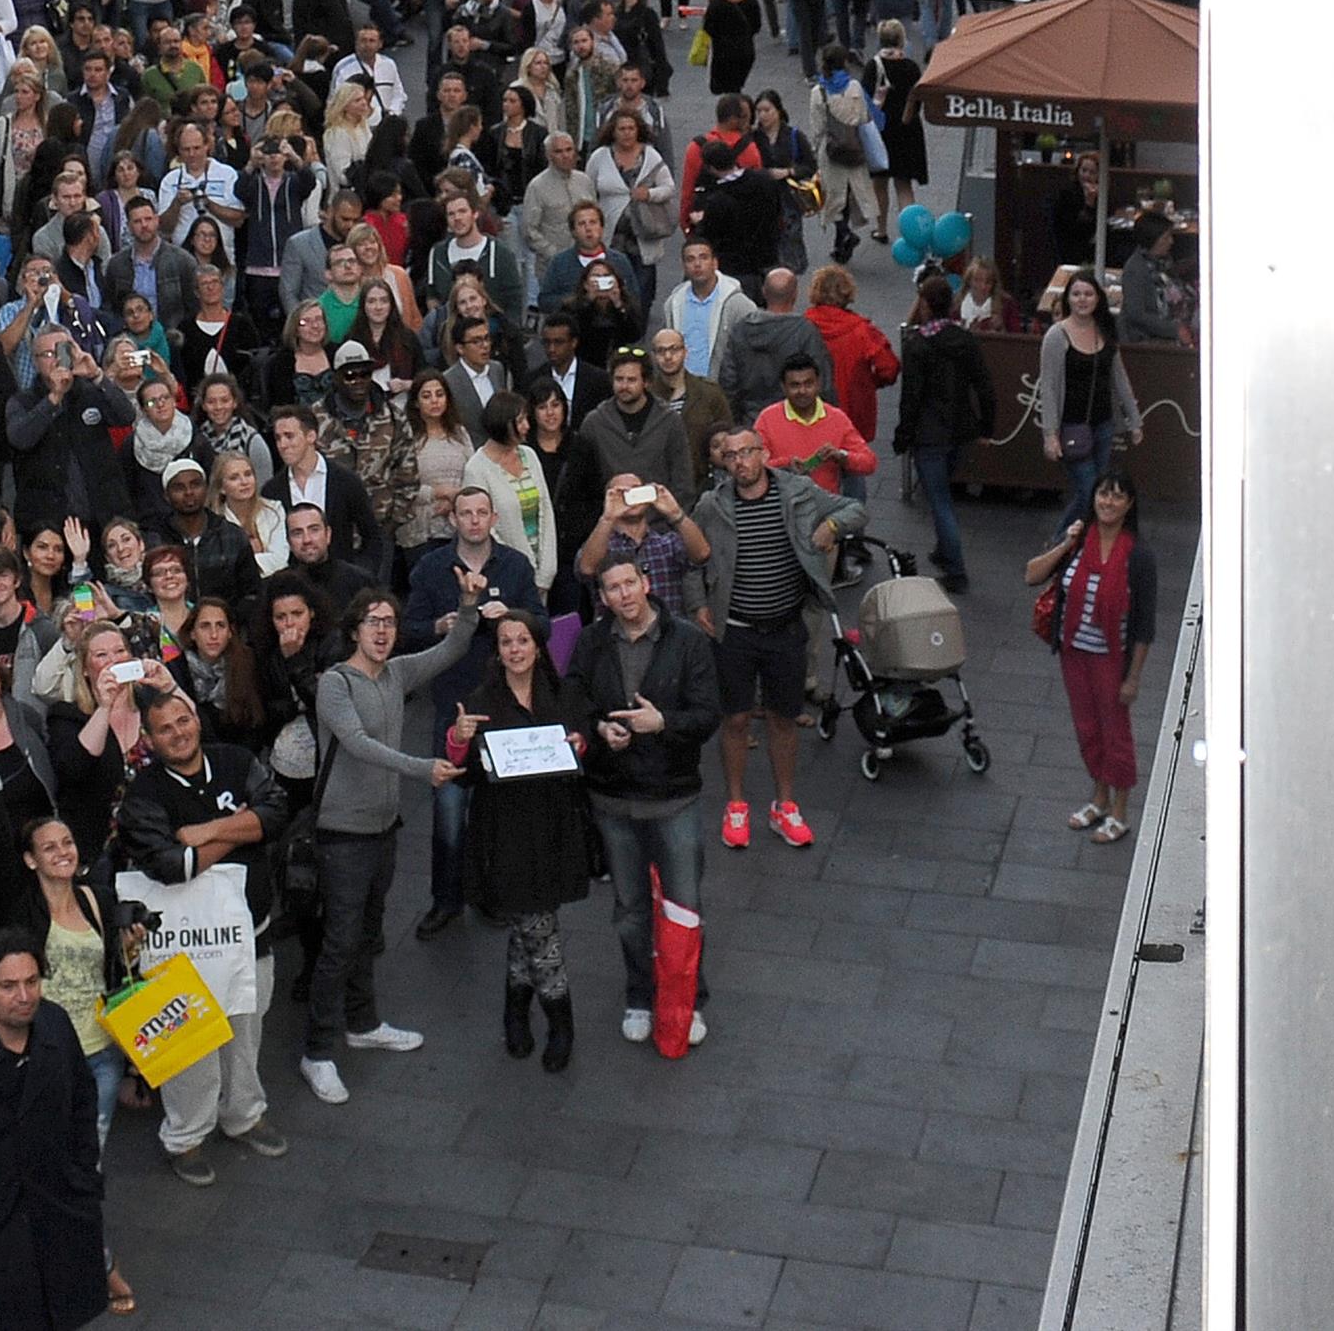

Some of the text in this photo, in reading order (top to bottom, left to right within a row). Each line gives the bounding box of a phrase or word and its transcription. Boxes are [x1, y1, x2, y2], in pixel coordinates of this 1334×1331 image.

[945, 94, 1074, 127] Bella Italia
[217, 790, 236, 810] R
[142, 925, 242, 950] HOP ONLINE
